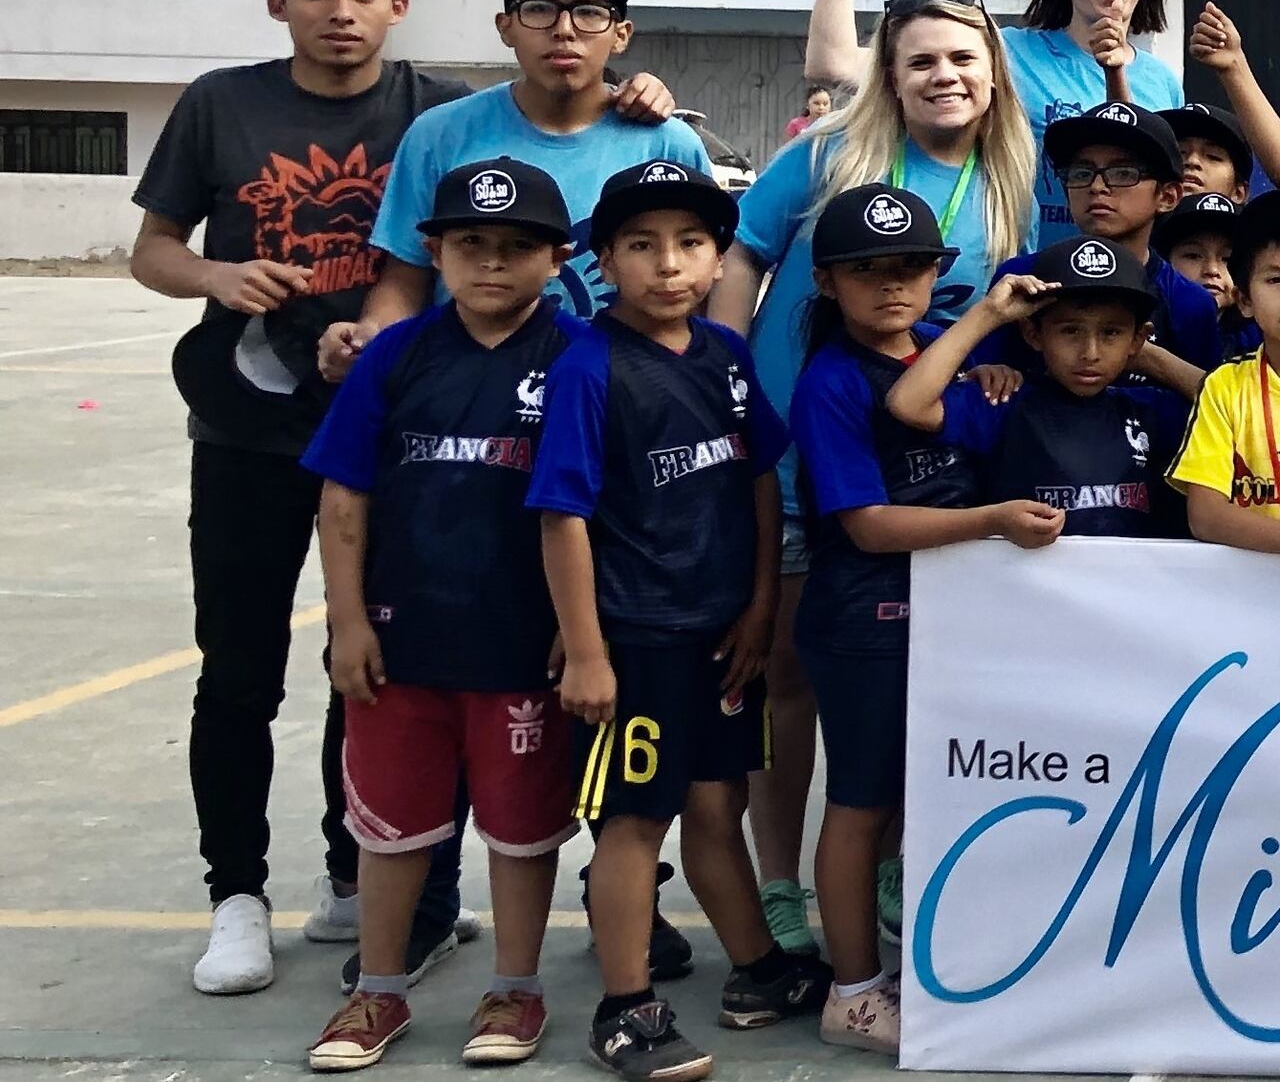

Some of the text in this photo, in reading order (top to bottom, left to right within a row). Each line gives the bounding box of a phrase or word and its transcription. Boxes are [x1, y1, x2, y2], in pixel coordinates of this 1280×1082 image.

[511, 727, 543, 755] 03
[624, 715, 660, 784] 6
[947, 738, 1111, 785] Make a
